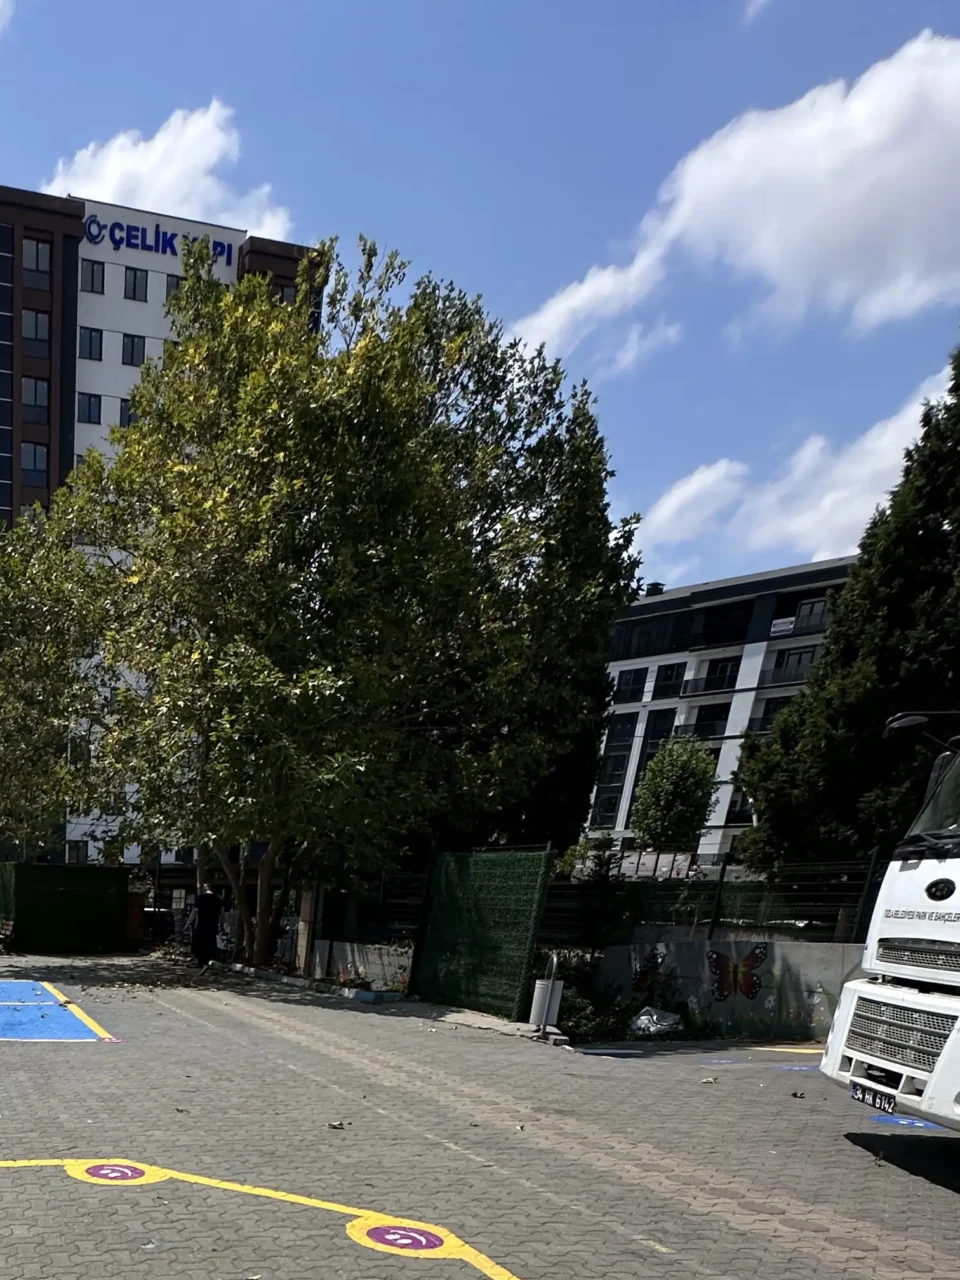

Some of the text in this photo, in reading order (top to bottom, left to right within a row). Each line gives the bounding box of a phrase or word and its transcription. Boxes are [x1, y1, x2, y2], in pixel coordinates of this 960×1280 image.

[108, 222, 233, 266] ÇELİK PI
[854, 1086, 863, 1101] 34
[875, 1094, 895, 1112] 6142
